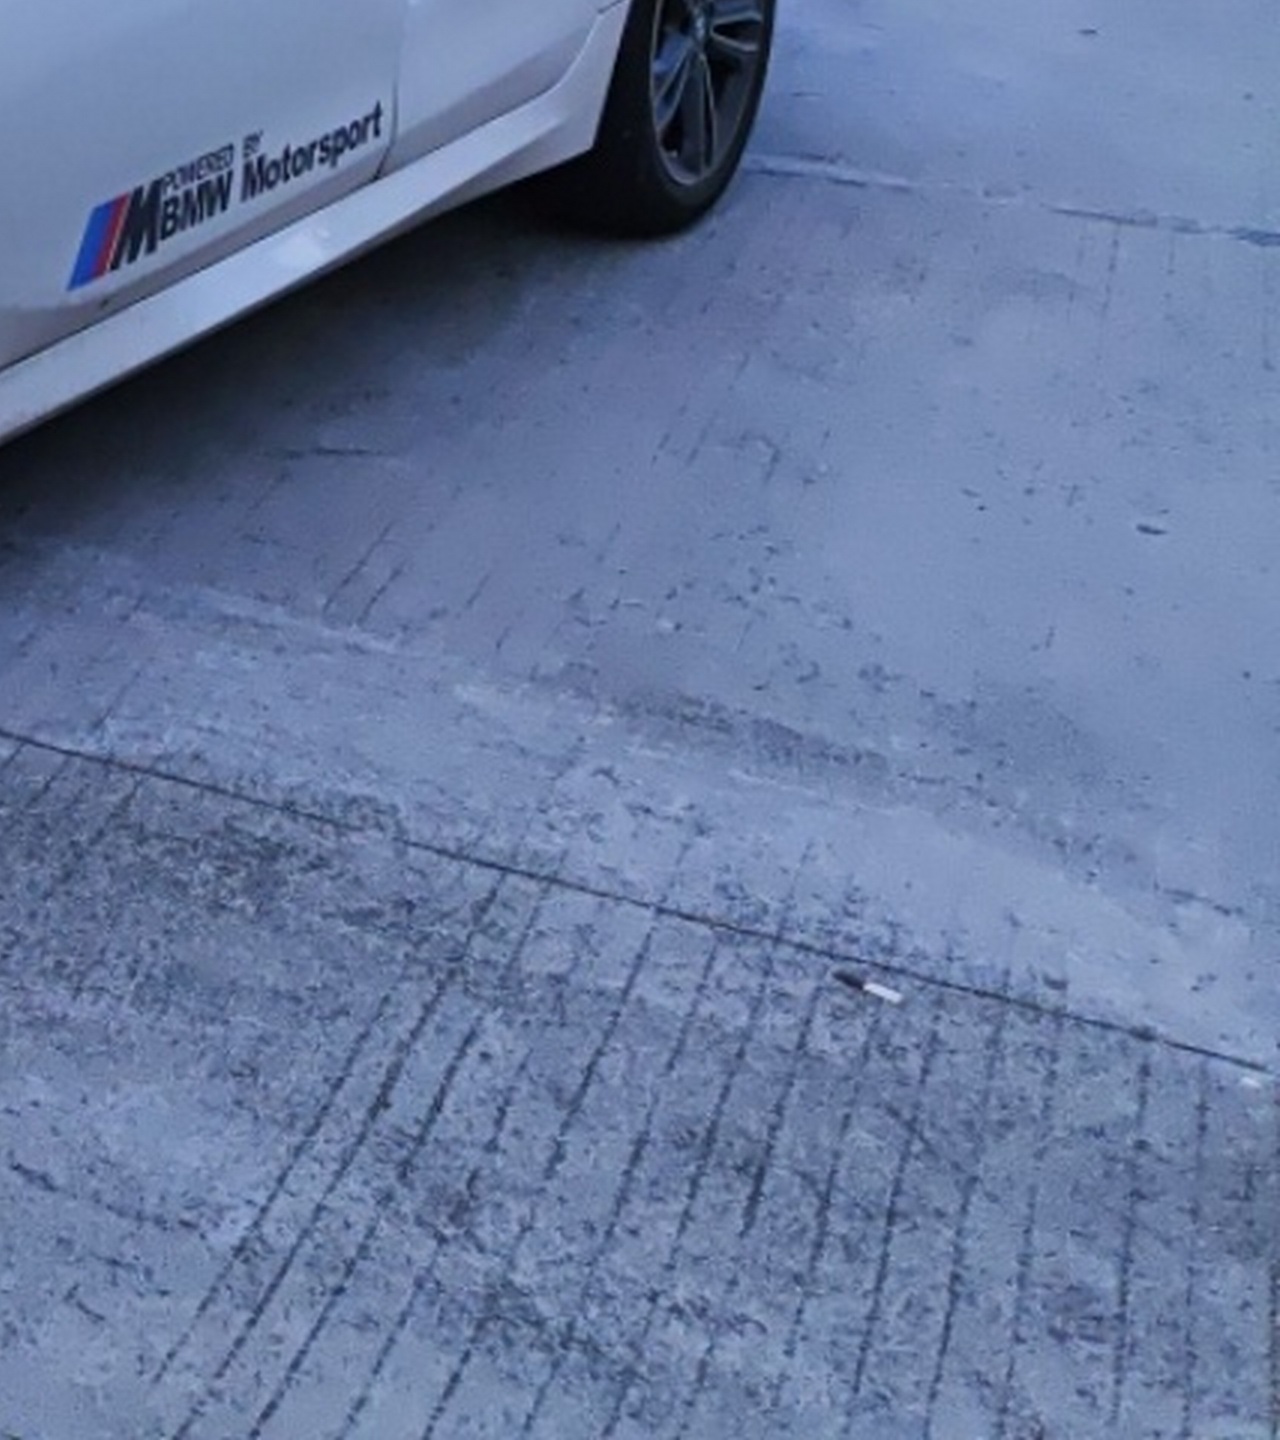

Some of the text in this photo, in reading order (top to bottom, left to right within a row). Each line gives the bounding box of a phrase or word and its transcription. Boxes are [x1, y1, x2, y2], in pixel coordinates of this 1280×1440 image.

[160, 100, 383, 241] BMW Motorsport
[161, 129, 264, 191] POWERED BY
